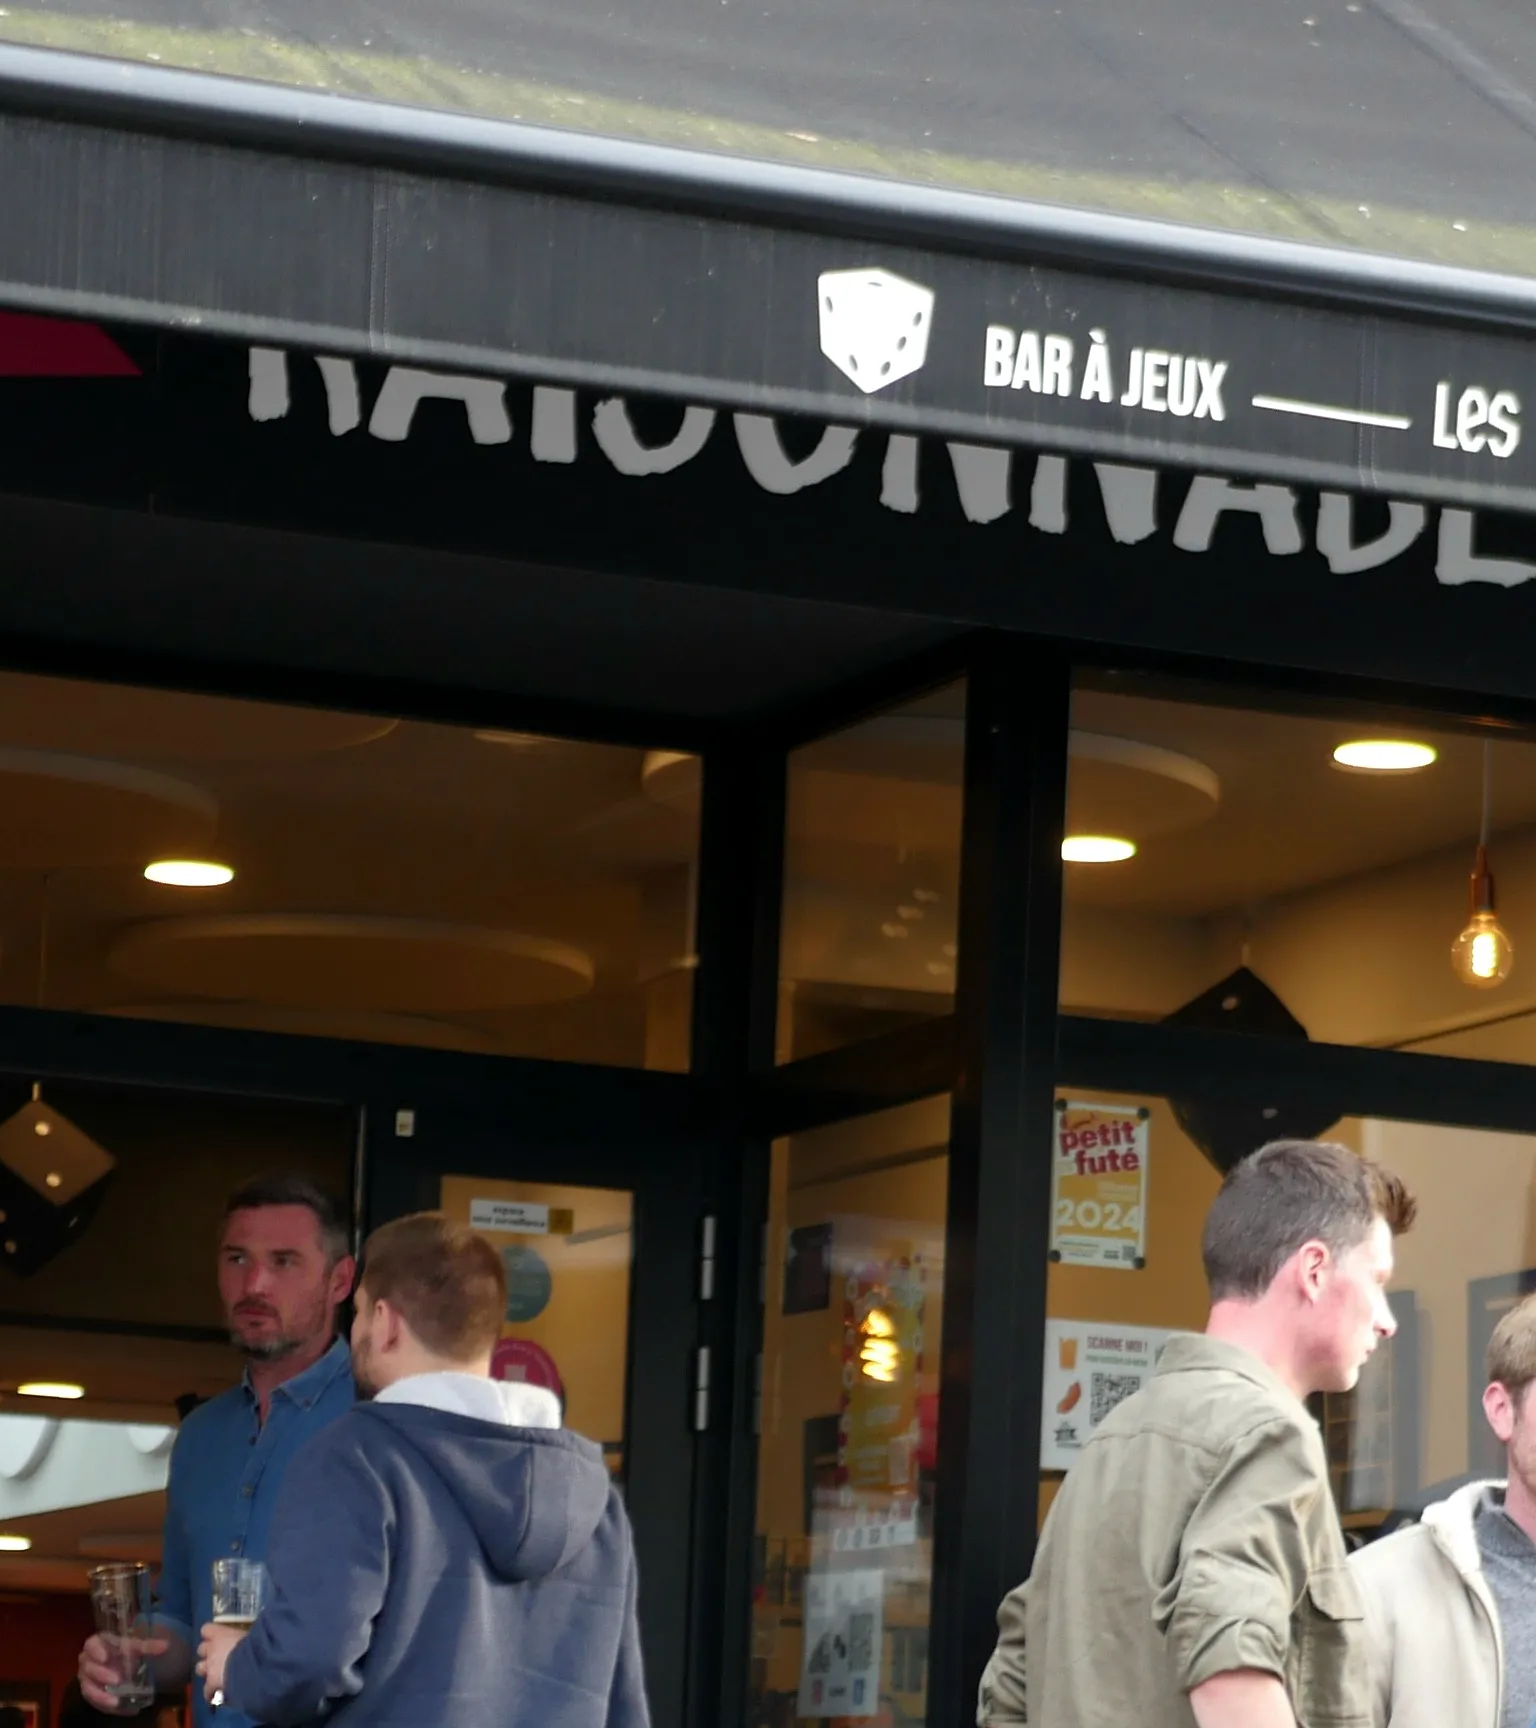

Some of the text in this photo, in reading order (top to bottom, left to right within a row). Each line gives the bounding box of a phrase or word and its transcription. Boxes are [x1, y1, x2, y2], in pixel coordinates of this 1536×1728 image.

[984, 325, 1229, 421] BAR À JEUX
[1059, 1120, 1136, 1156] petit
[1074, 1147, 1140, 1176] futé
[1056, 1198, 1142, 1233] 2024
